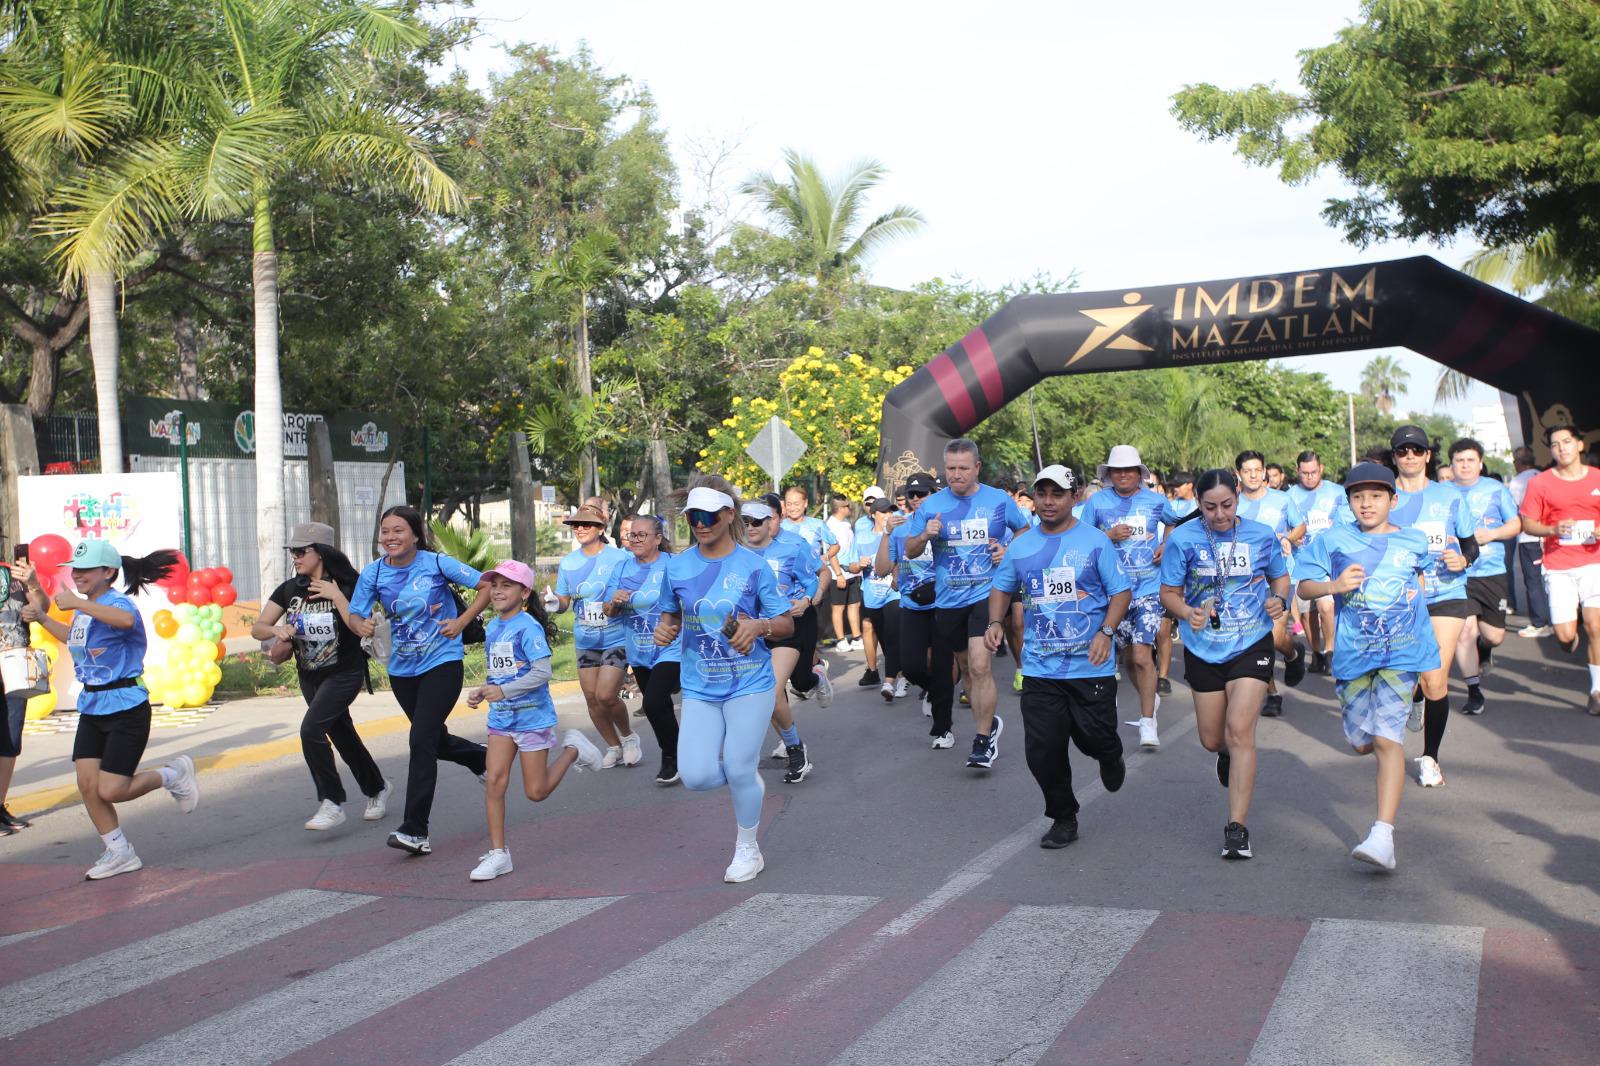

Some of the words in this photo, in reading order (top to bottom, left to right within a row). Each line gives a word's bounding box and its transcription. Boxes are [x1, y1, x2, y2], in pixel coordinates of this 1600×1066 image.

[1173, 267, 1376, 320] IMDEM
[1172, 304, 1374, 350] MAZATLÁN
[1172, 349, 1231, 360] INSTITUTO
[1234, 344, 1292, 355] MUNICIPAL
[1297, 341, 1317, 350] DEL
[1321, 335, 1371, 347] DEPORTE
[966, 529, 986, 540] 129
[1131, 526, 1144, 535] 28
[1427, 535, 1443, 544] 35
[1221, 556, 1247, 568] 143
[1048, 581, 1073, 595] 298
[588, 612, 605, 621] 114
[73, 627, 85, 639] 123
[309, 625, 331, 635] 063
[492, 656, 513, 668] 095
